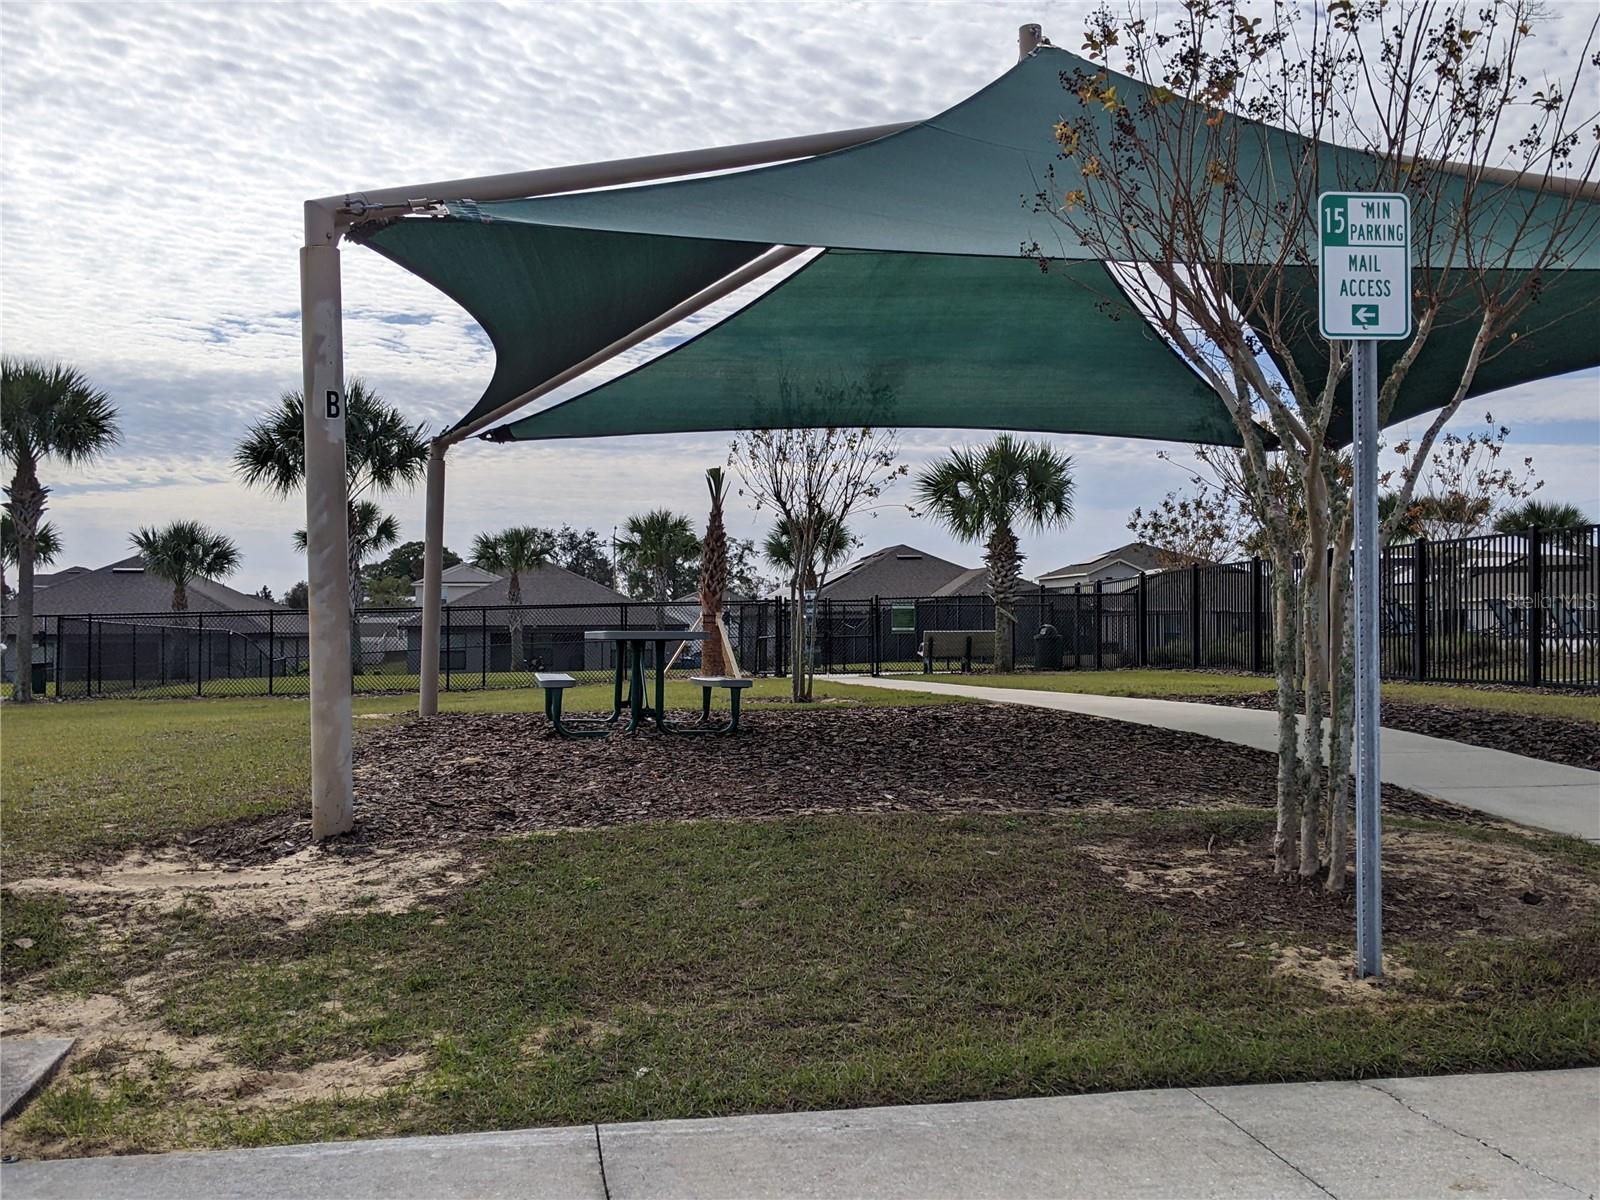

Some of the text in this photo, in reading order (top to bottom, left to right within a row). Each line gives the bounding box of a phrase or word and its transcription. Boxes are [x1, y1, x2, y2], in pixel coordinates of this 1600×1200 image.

[1325, 202, 1390, 234] 15 MIN
[1351, 224, 1404, 242] PARKING
[1349, 254, 1381, 272] MAIL
[1340, 279, 1391, 297] ACCESS
[327, 390, 340, 418] B
